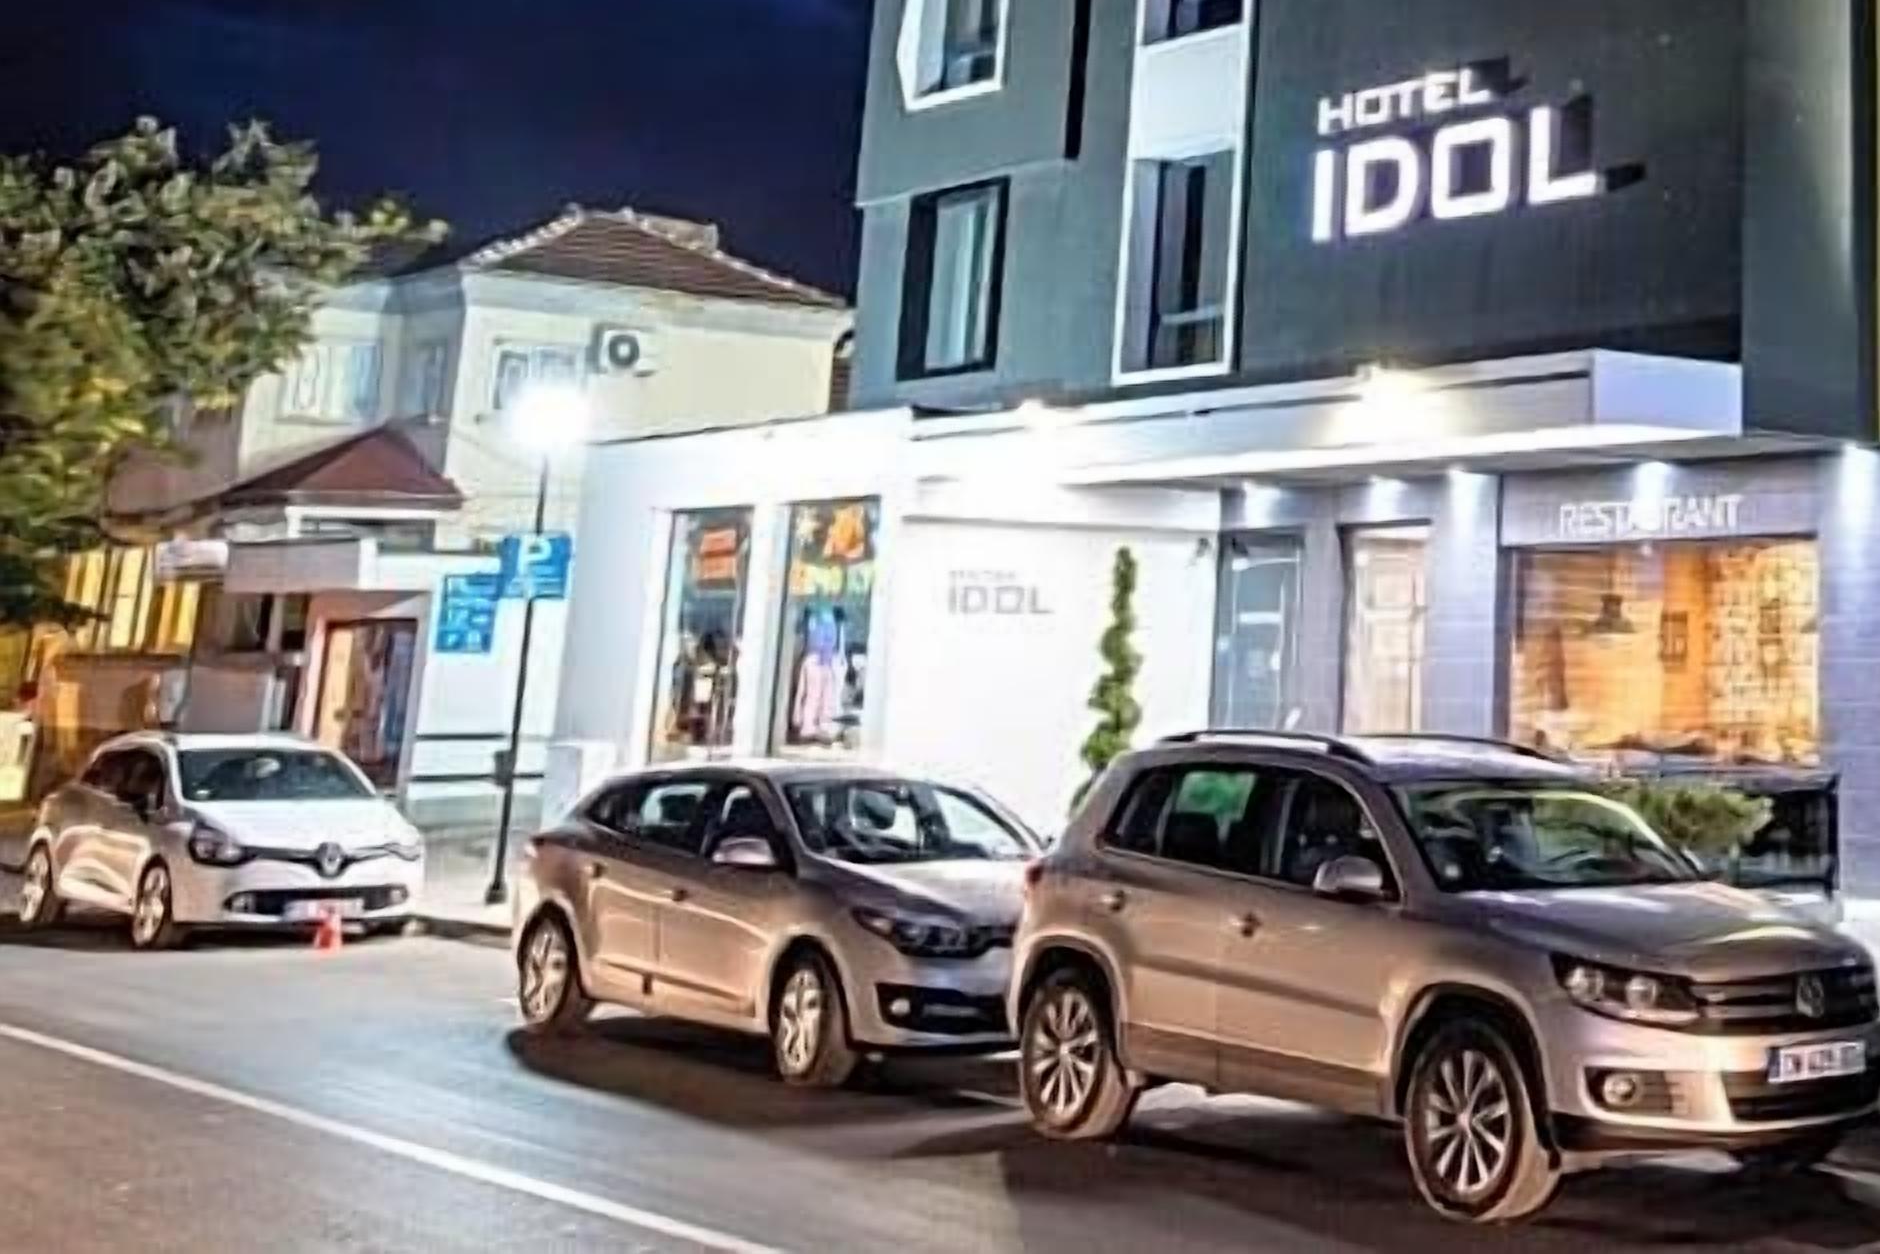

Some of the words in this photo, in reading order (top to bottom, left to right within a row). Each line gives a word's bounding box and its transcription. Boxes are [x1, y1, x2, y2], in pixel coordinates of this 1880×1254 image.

[1318, 67, 1491, 136] HOTEL
[1312, 106, 1600, 243] IDOL
[516, 536, 552, 577] P
[947, 584, 1056, 615] IDOL
